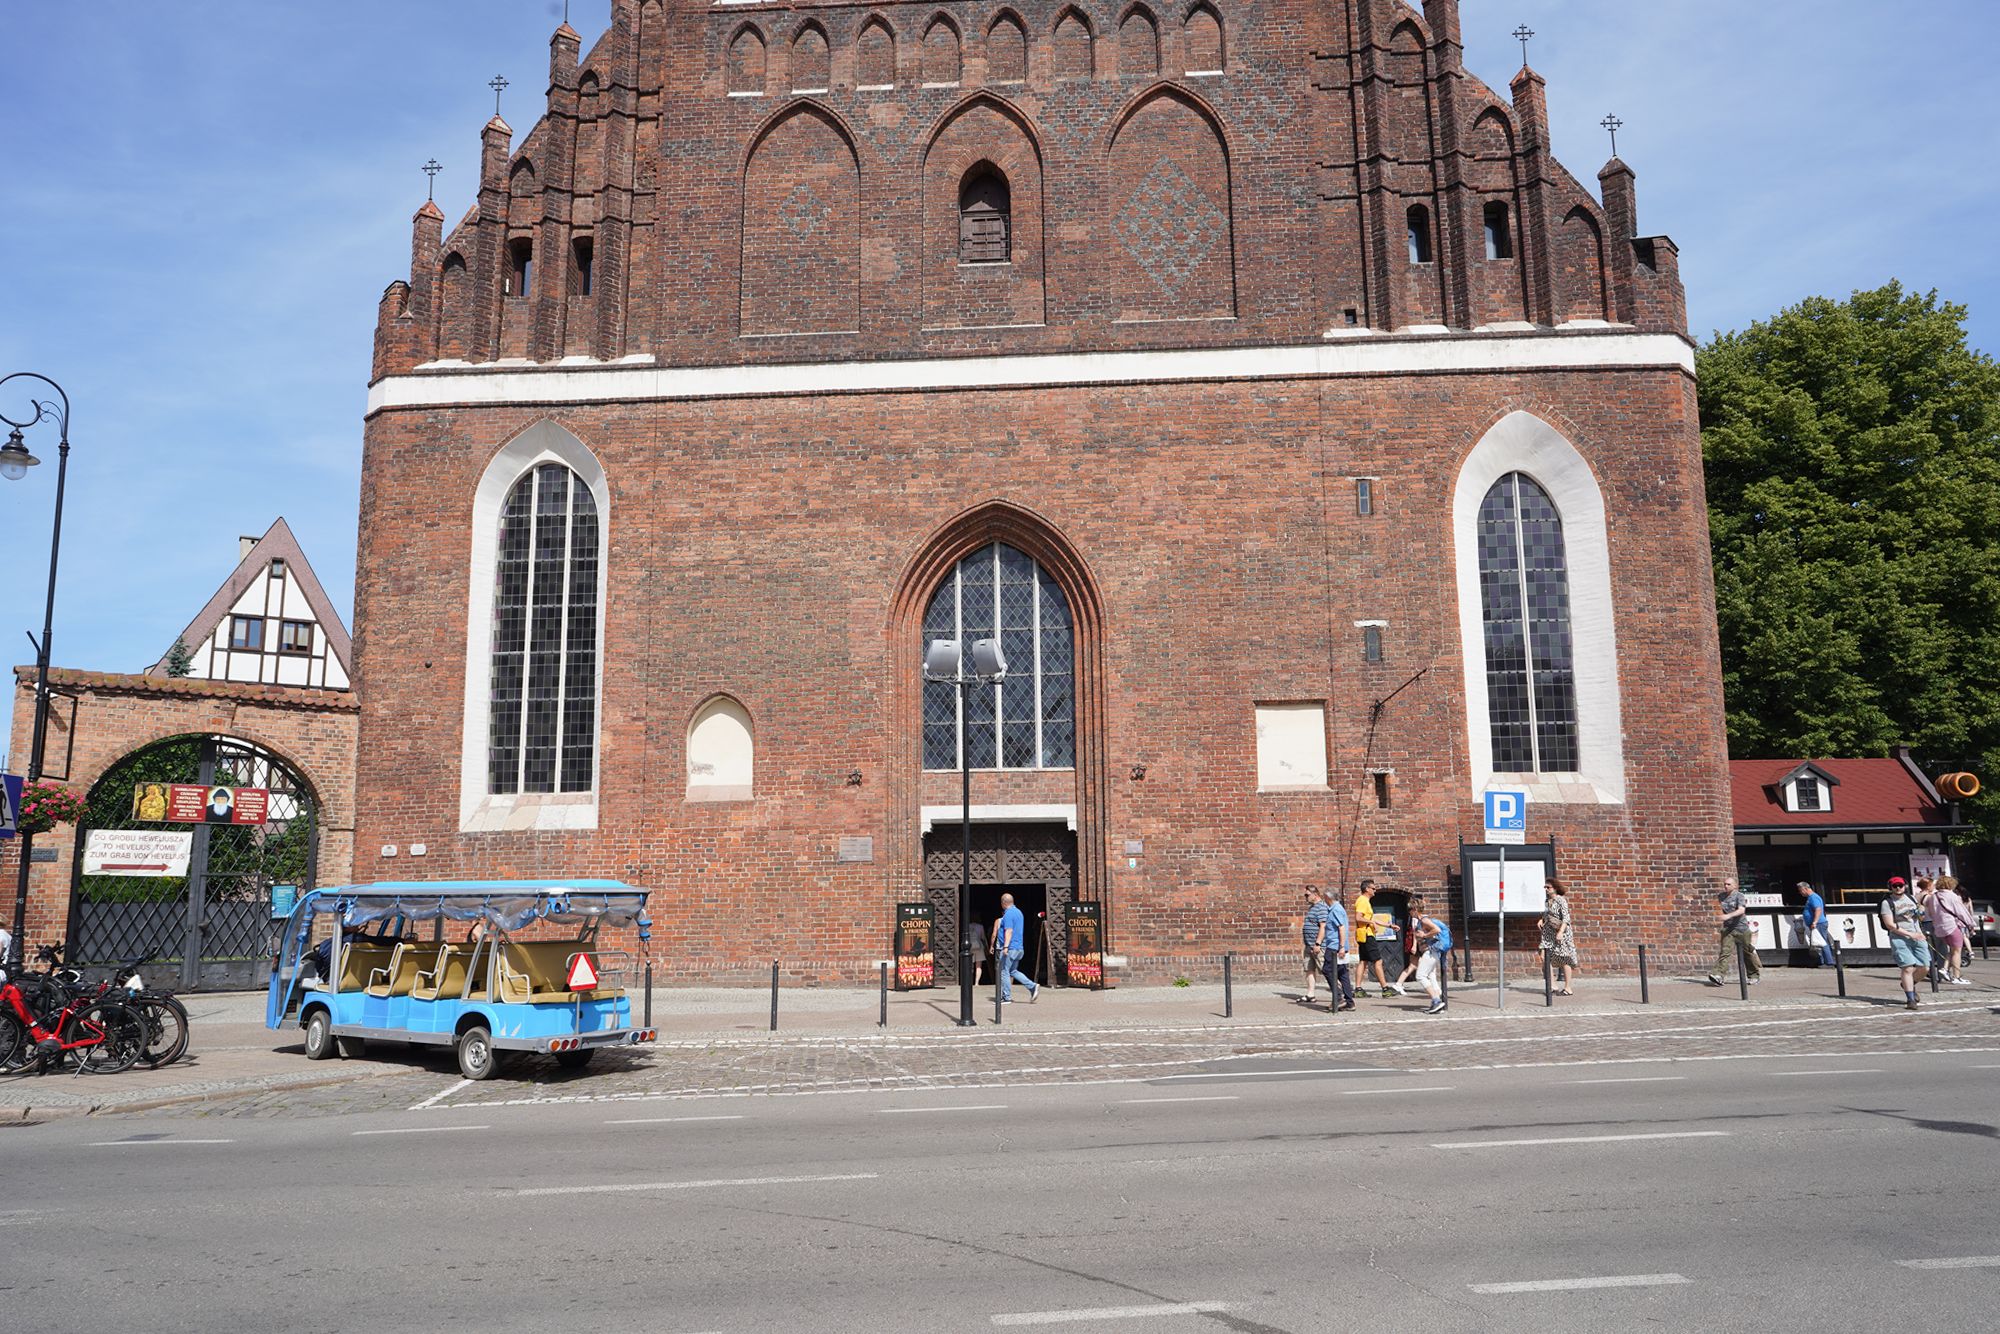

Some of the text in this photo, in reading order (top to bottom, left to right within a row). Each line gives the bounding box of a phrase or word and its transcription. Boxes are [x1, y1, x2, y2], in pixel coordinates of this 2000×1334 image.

[1493, 794, 1516, 827] P
[108, 834, 136, 842] GROBU
[116, 843, 151, 851] HEVELIUS
[901, 920, 931, 928] CHOPIN
